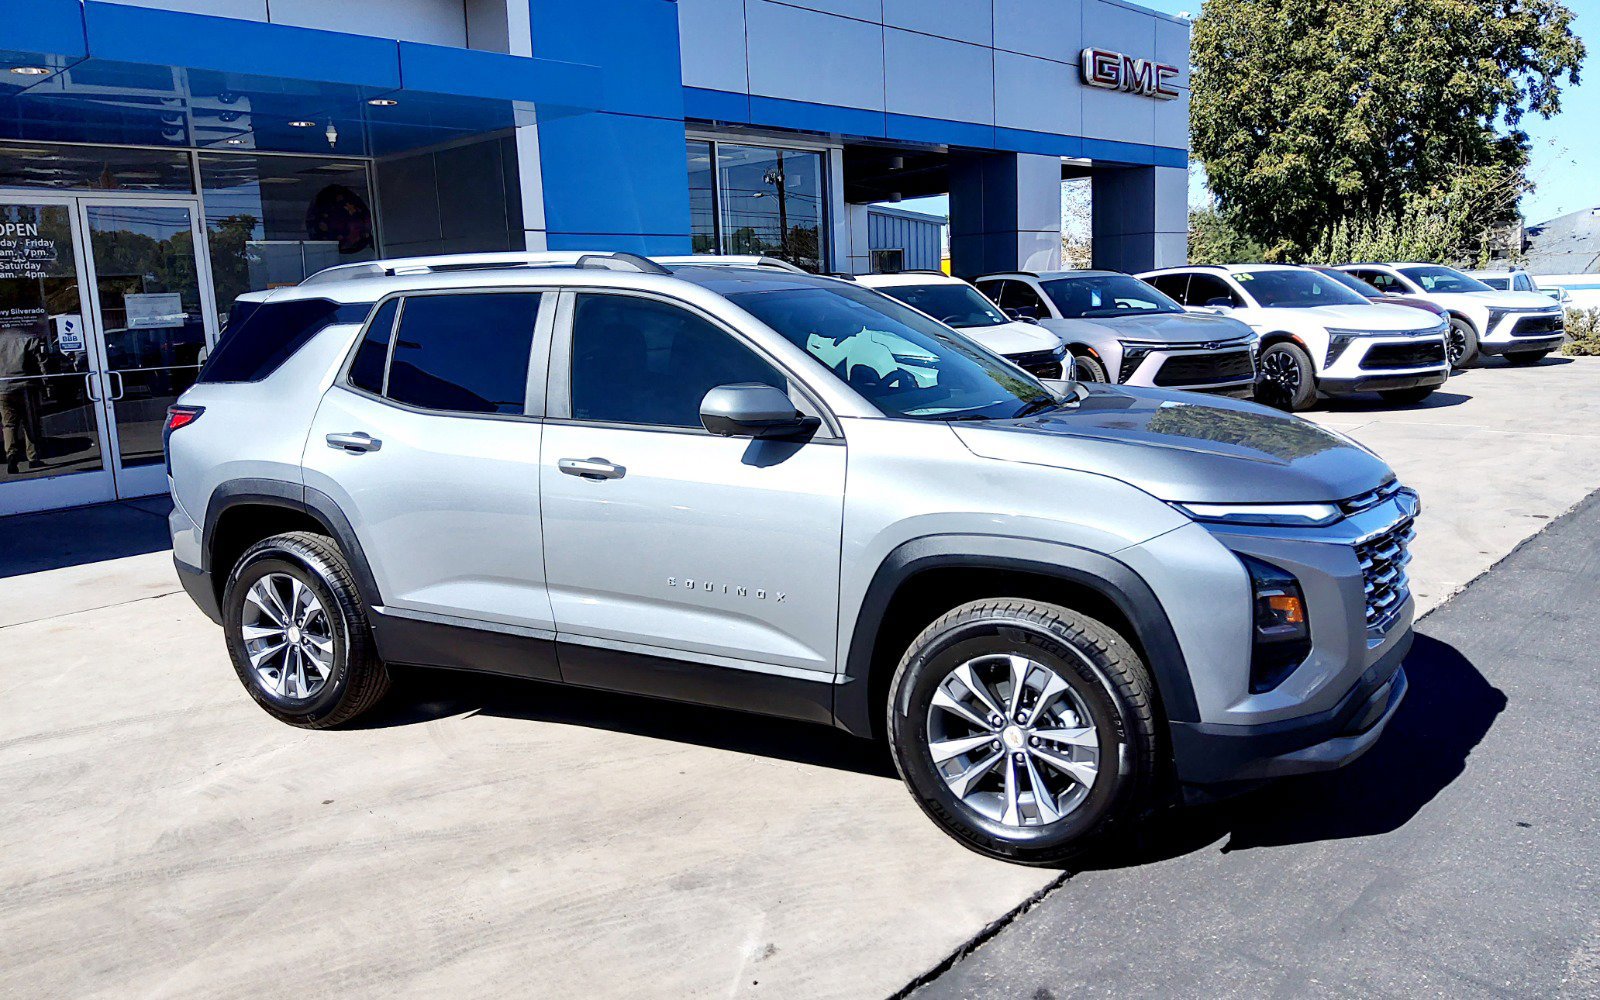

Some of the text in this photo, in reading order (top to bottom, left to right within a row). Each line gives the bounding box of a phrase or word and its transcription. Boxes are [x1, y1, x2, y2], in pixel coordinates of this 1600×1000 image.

[1081, 47, 1180, 101] GMC
[25, 239, 54, 248] Friday
[0, 262, 41, 270] Saturday
[25, 271, 49, 279] 4pm.
[667, 576, 786, 603] EQUINOX
